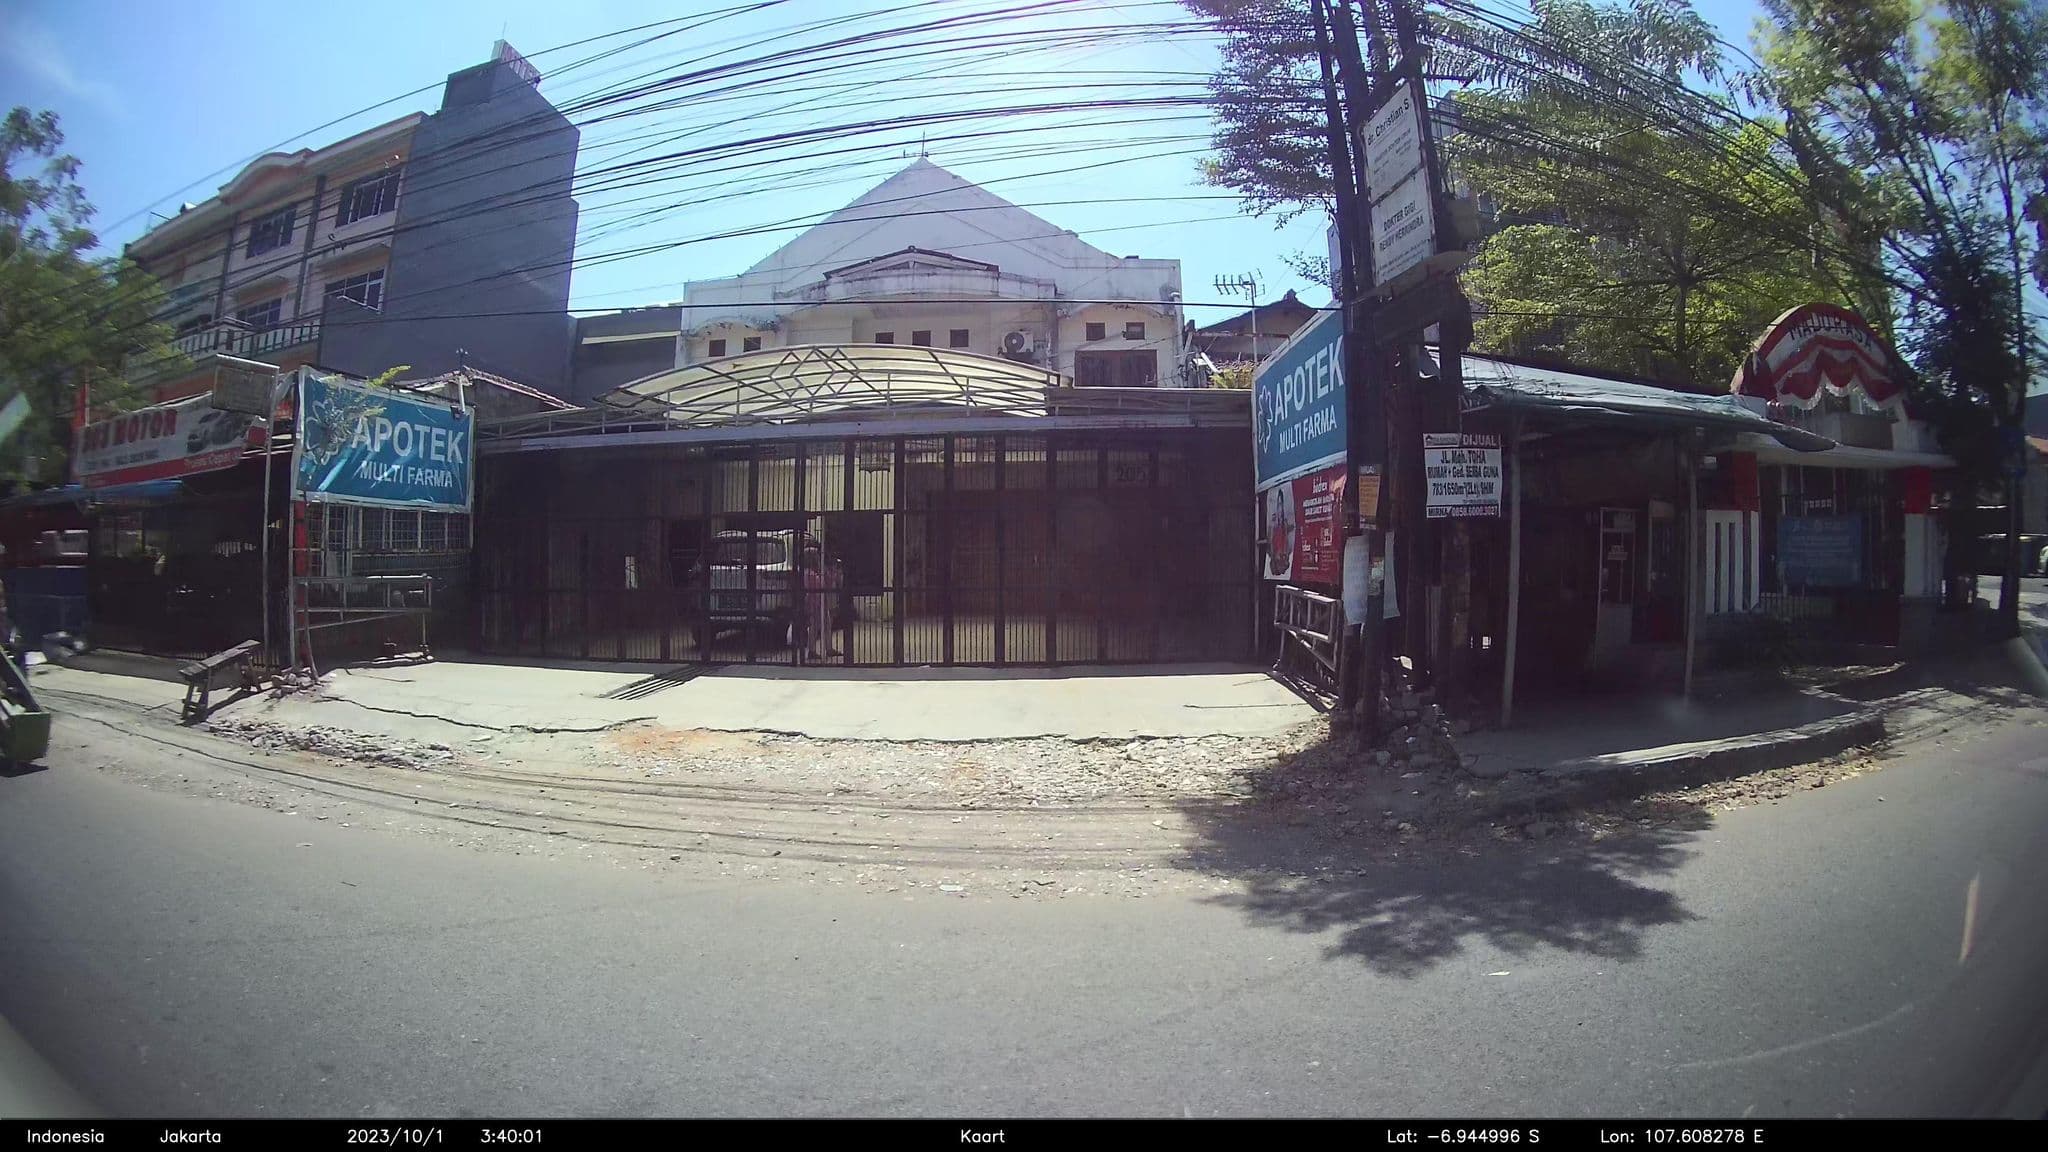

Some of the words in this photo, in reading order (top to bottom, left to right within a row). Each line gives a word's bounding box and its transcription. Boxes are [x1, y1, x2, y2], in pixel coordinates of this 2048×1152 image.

[1375, 106, 1404, 137] Christian
[1403, 98, 1410, 110] S
[1383, 209, 1404, 231] DOKTER
[1274, 335, 1344, 426] APOTEK
[351, 415, 464, 464] APOTEK
[1279, 422, 1302, 454] MULTI
[1303, 405, 1338, 443] FARMA
[1462, 434, 1498, 446] DIJUAL
[1468, 450, 1486, 464] TOHA
[359, 460, 404, 484] MULTI
[407, 466, 454, 488] FARMA
